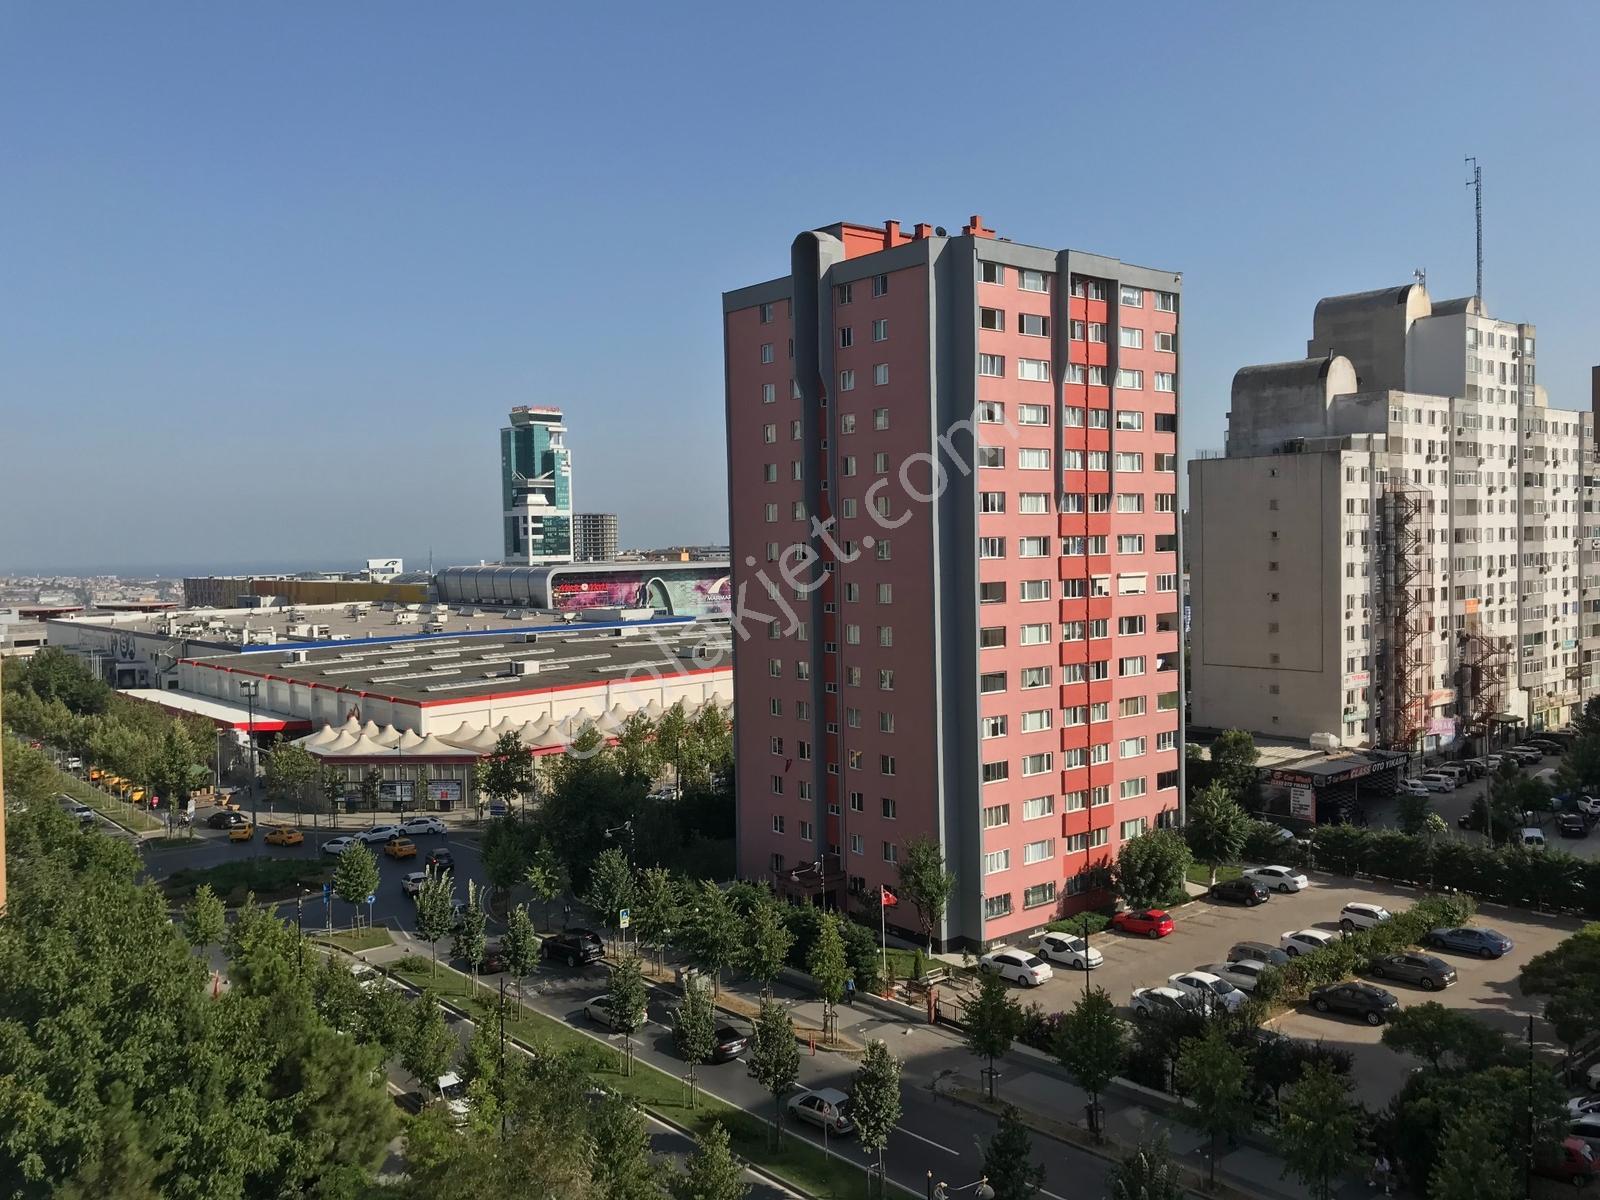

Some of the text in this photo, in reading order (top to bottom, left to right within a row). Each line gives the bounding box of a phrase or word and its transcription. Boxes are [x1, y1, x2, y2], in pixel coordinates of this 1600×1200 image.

[1350, 765, 1371, 779] CLASS
[1372, 762, 1384, 772] OTO
[1385, 756, 1407, 769] YIKAMA
